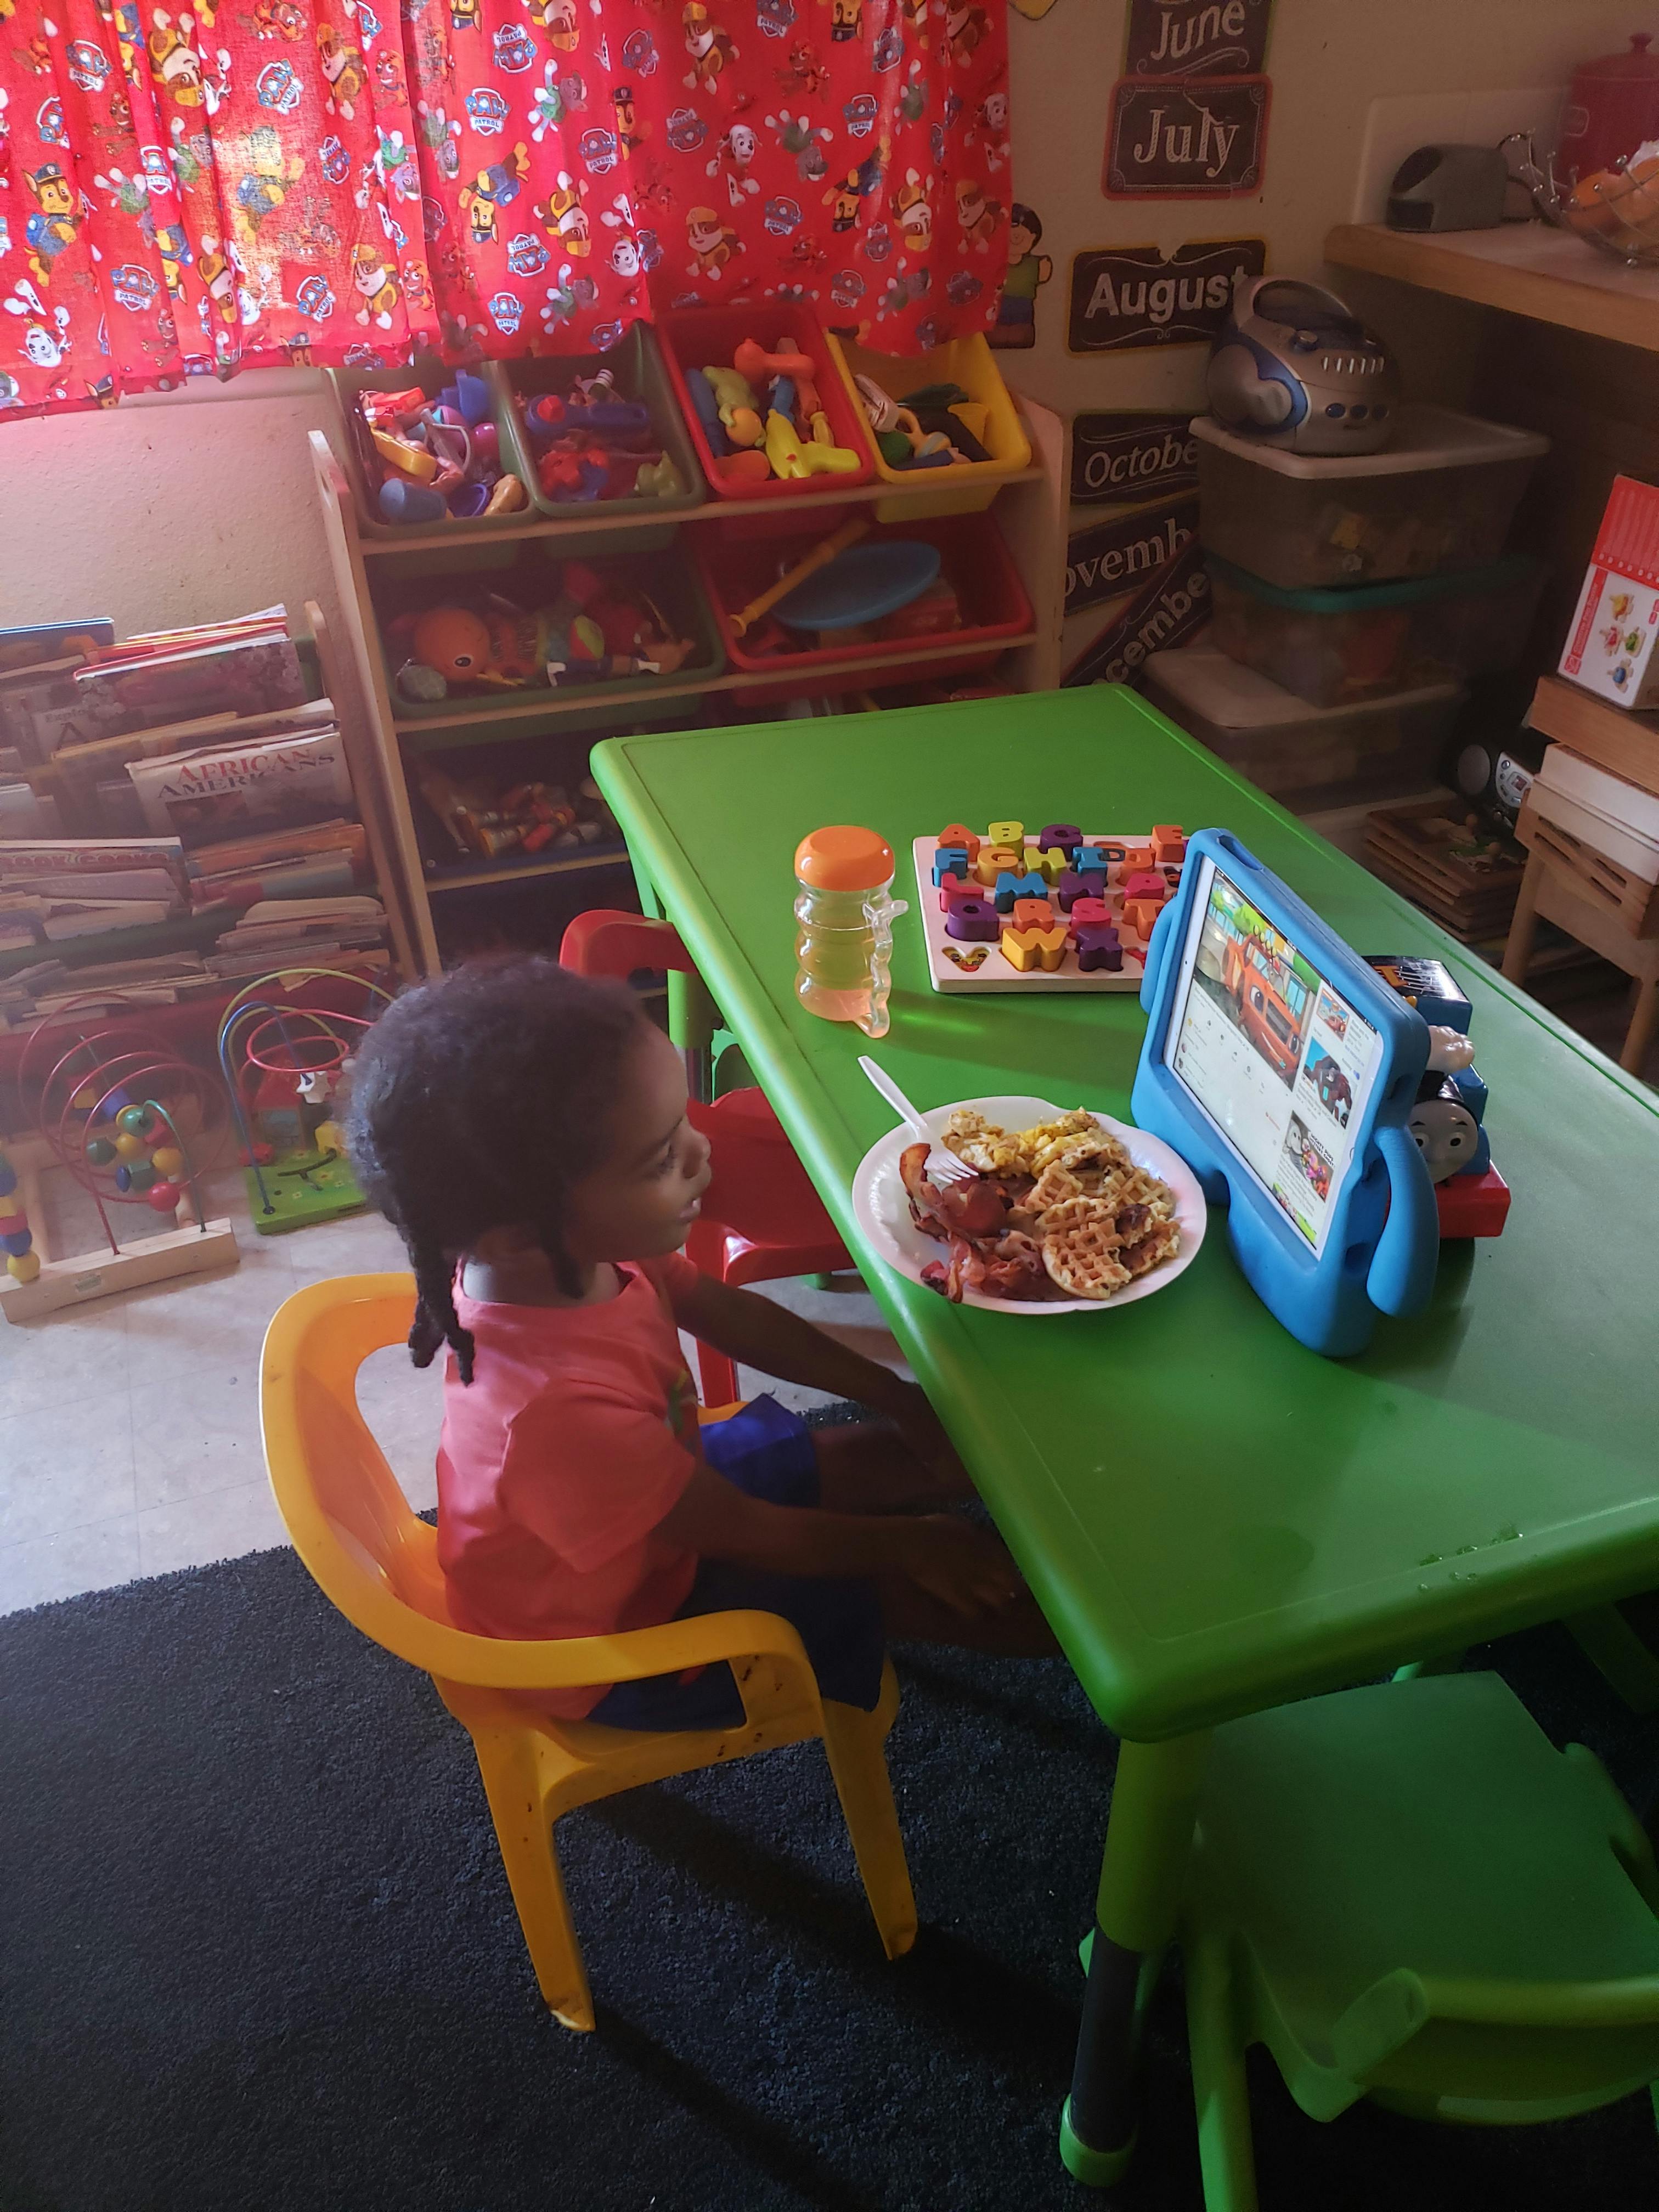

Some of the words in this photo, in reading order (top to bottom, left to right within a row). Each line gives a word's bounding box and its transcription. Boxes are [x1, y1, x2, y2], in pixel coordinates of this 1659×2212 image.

[496, 31, 522, 42] PATROL
[1150, 0, 1245, 60] June
[258, 58, 294, 108] PAW
[280, 83, 299, 109] PATROL
[465, 94, 511, 119] PAW
[474, 119, 500, 128] PATROL
[1133, 108, 1240, 178] July
[589, 155, 614, 168] PATROL
[511, 239, 535, 251] PATROL
[111, 268, 160, 298] PAW
[297, 275, 329, 317] PAW
[119, 292, 147, 306] PATROL
[315, 295, 334, 320] PATROL
[488, 298, 525, 319] PAW
[498, 319, 517, 328] PATROL
[1085, 433, 1199, 489] Octobe
[1064, 517, 1191, 597] ovemb
[1093, 572, 1207, 685] cembe
[176, 748, 312, 785] AFRICAN
